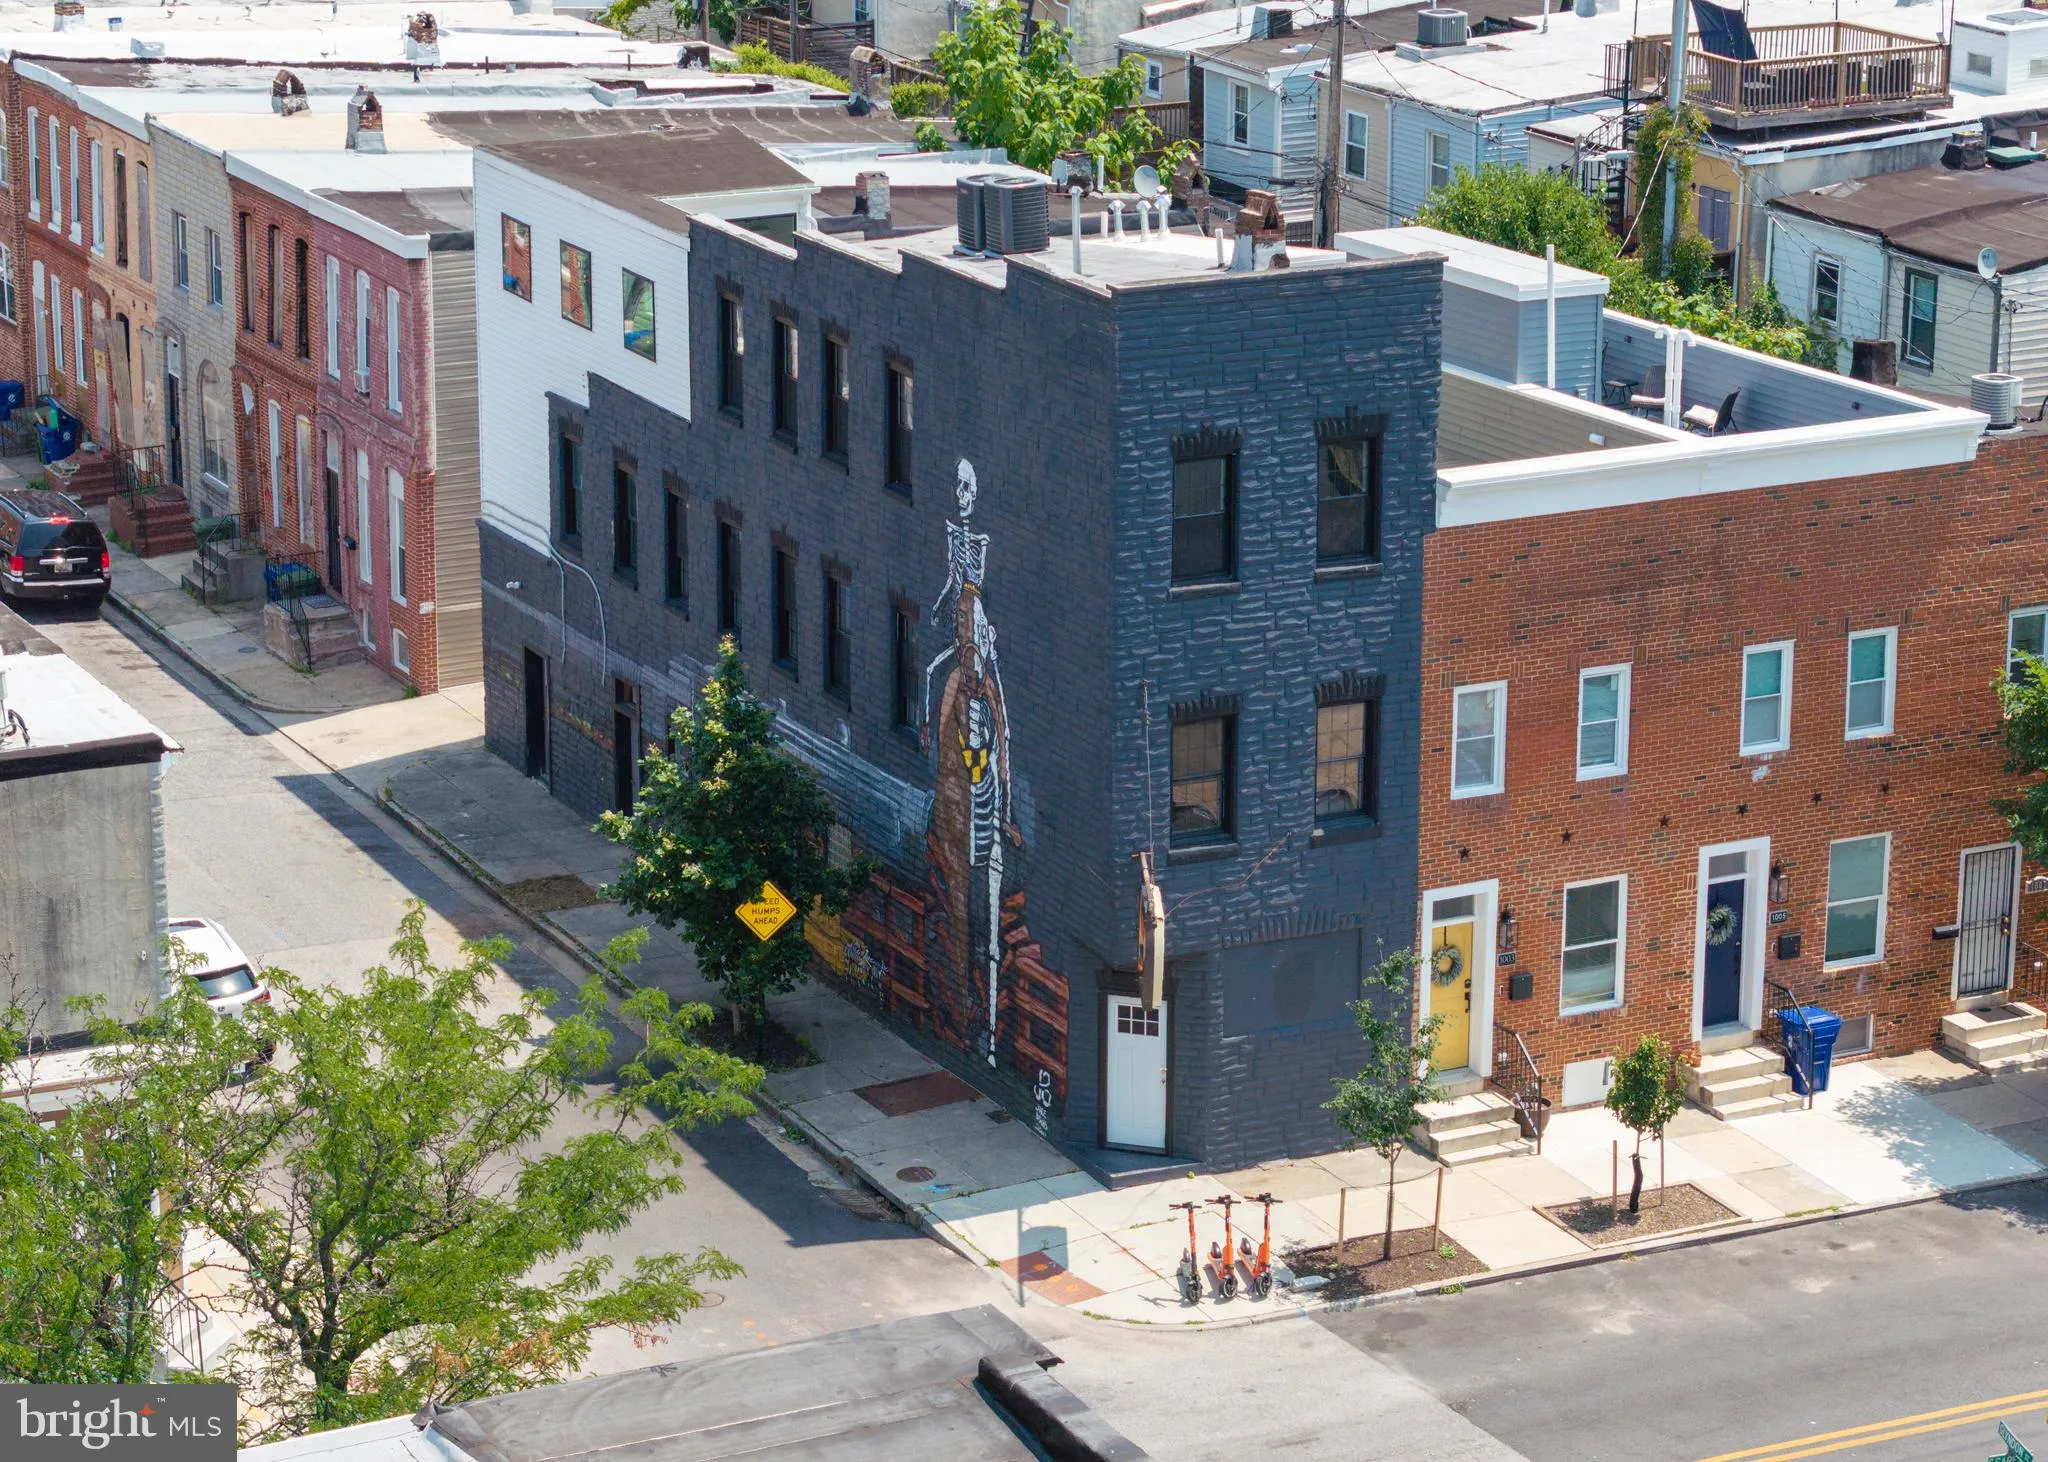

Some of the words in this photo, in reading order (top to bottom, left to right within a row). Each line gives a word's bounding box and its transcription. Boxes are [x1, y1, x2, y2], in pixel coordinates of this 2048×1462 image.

[751, 907, 781, 915] HUMPS
[1772, 912, 1786, 921] 1005
[753, 917, 778, 925] AHEAD
[1499, 954, 1515, 964] 1003
